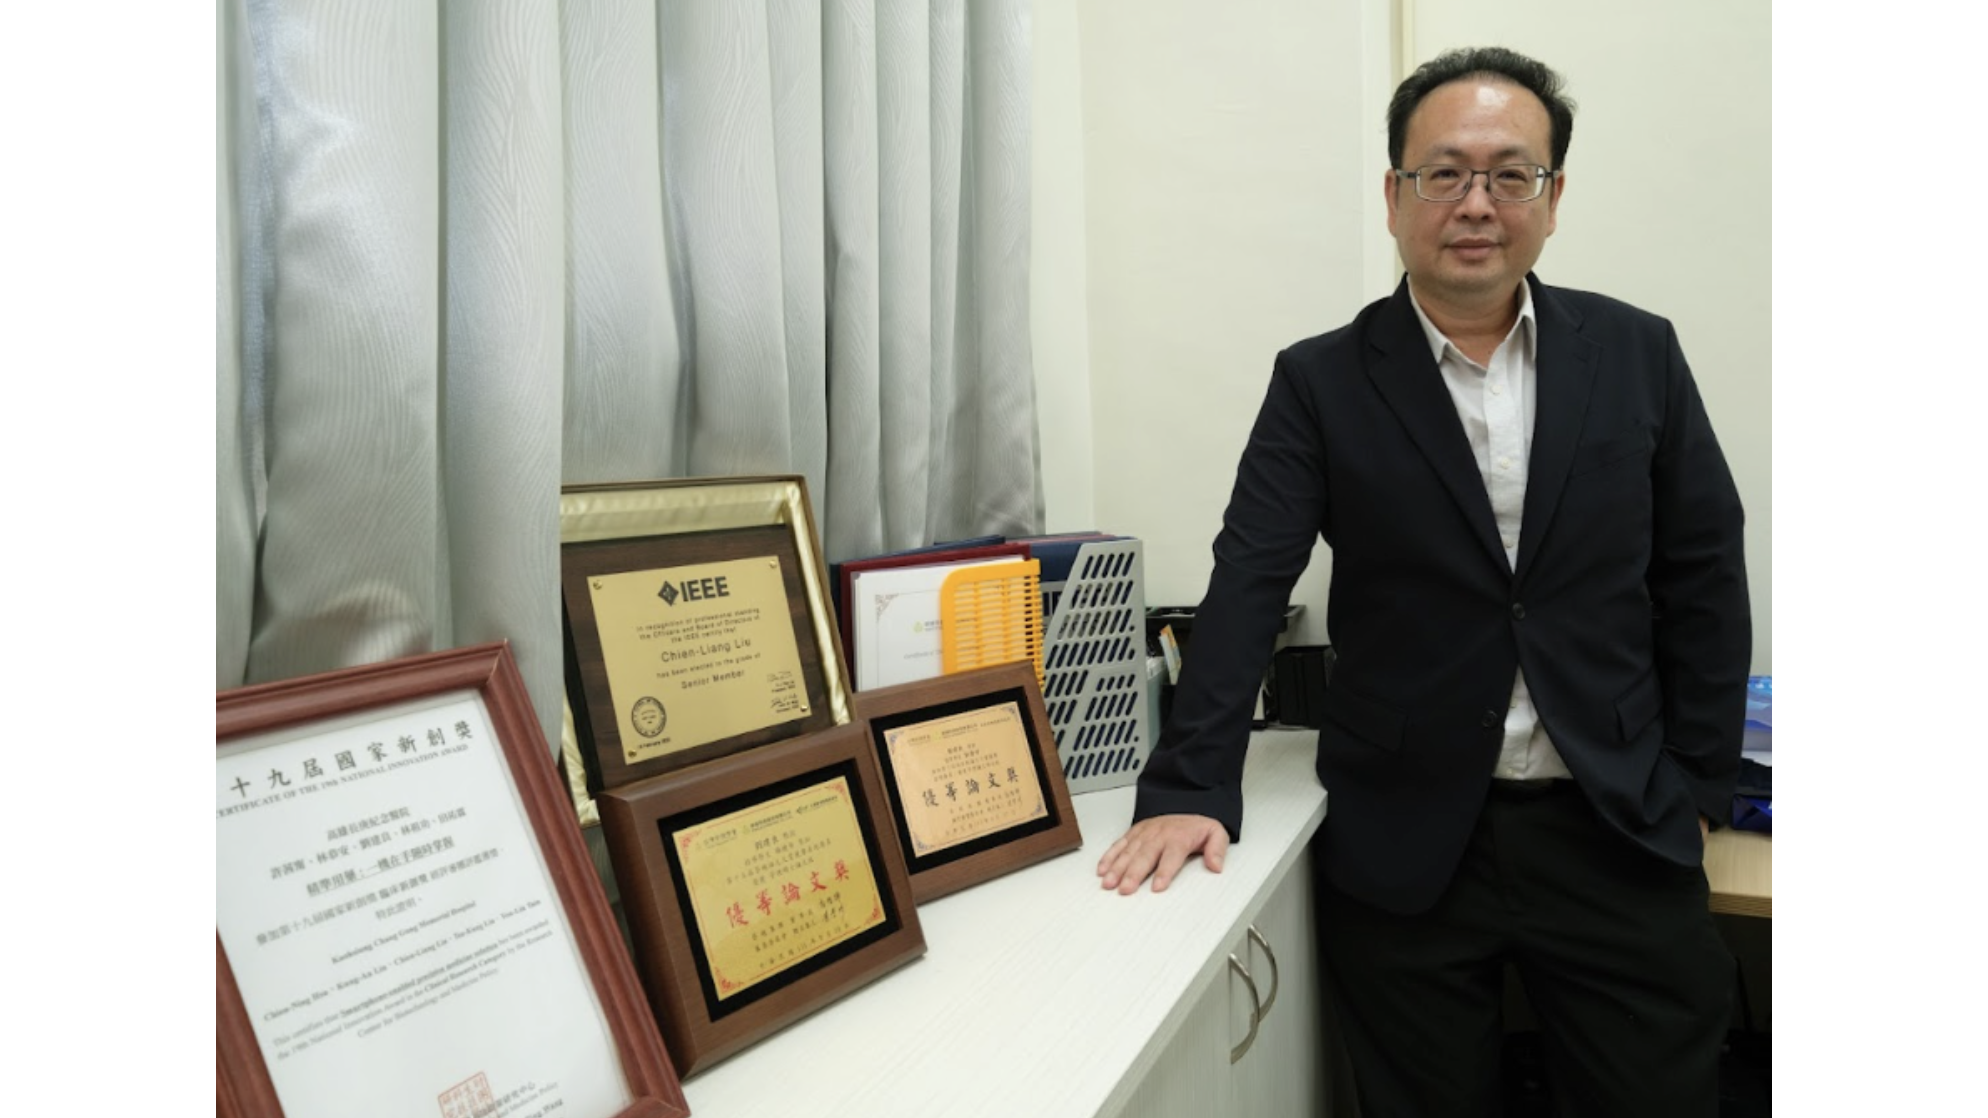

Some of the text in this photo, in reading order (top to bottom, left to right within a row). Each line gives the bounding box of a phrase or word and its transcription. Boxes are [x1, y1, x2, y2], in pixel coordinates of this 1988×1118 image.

[680, 576, 730, 602] IEEE
[661, 639, 751, 663] Chien-Liang Liu
[681, 670, 744, 690] Senior Member
[216, 743, 469, 819] ERTIFICATE OF THE 19th NATIONAL INNOVATION AWARD
[373, 933, 399, 947] Chang
